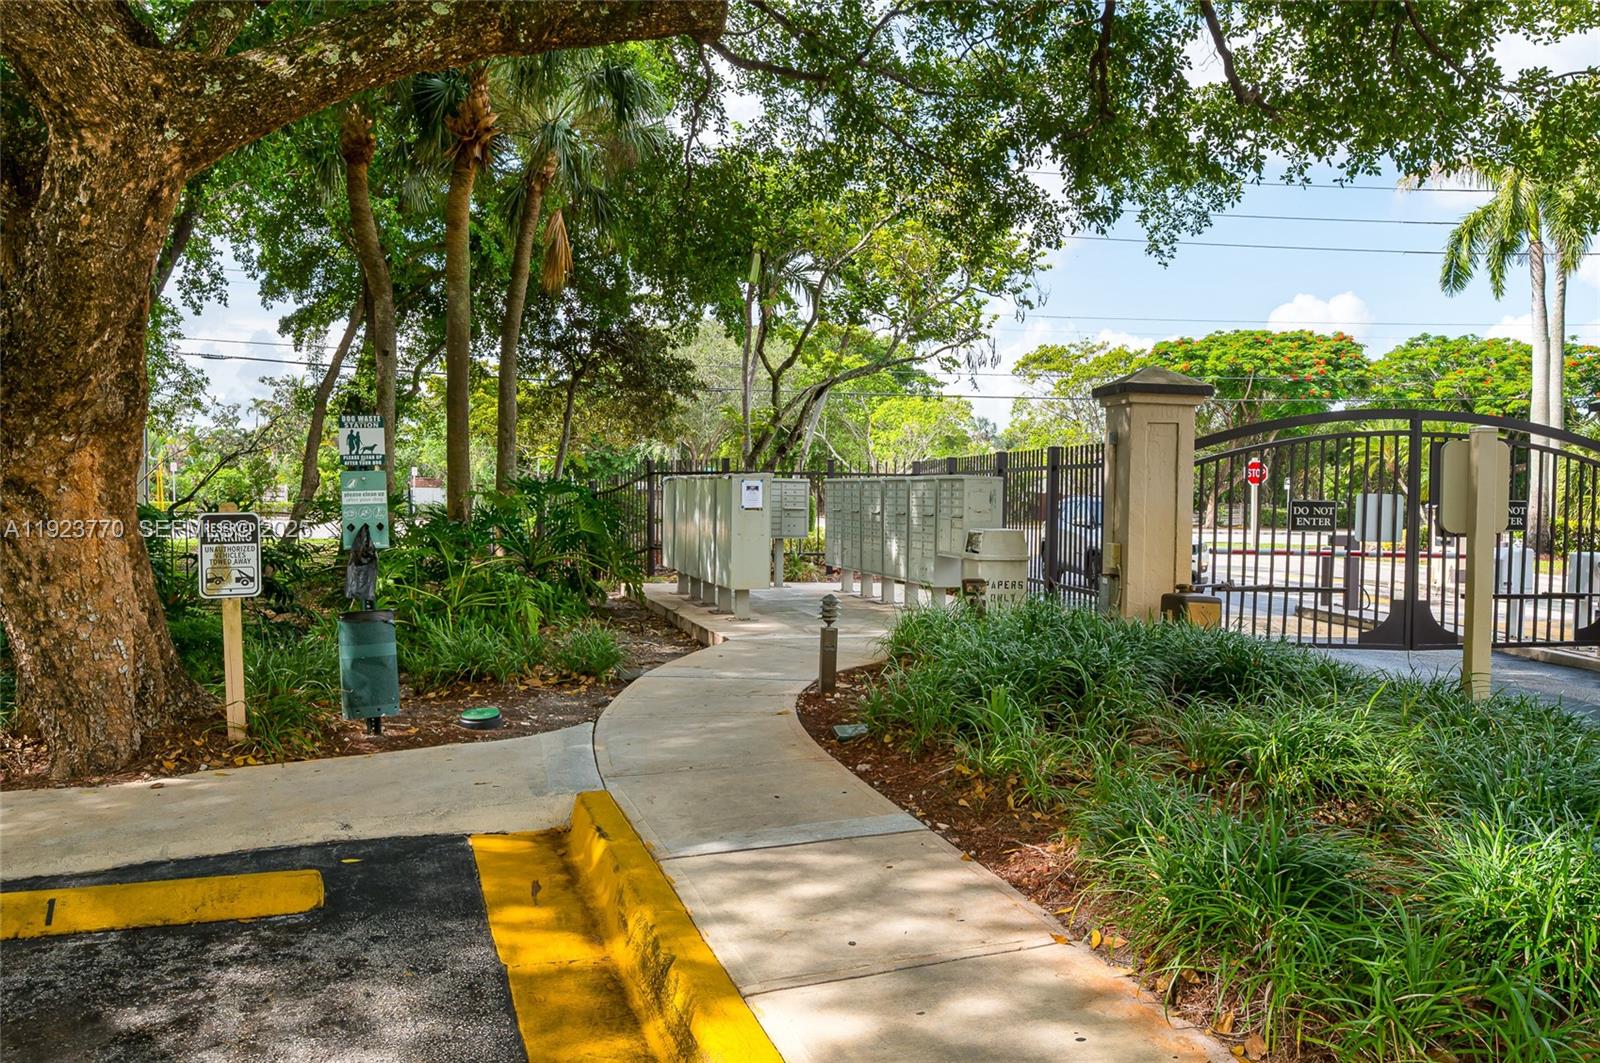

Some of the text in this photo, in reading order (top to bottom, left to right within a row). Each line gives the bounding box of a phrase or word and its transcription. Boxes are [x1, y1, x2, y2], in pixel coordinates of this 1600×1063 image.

[1293, 506, 1335, 516] DO NOT
[1296, 517, 1331, 527] ENTER
[203, 522, 256, 533] RESERVED
[207, 532, 253, 543] PARKING
[204, 545, 256, 553] UNAUTHORIZED
[990, 593, 1016, 602] ONLY
[44, 898, 57, 927] 1
